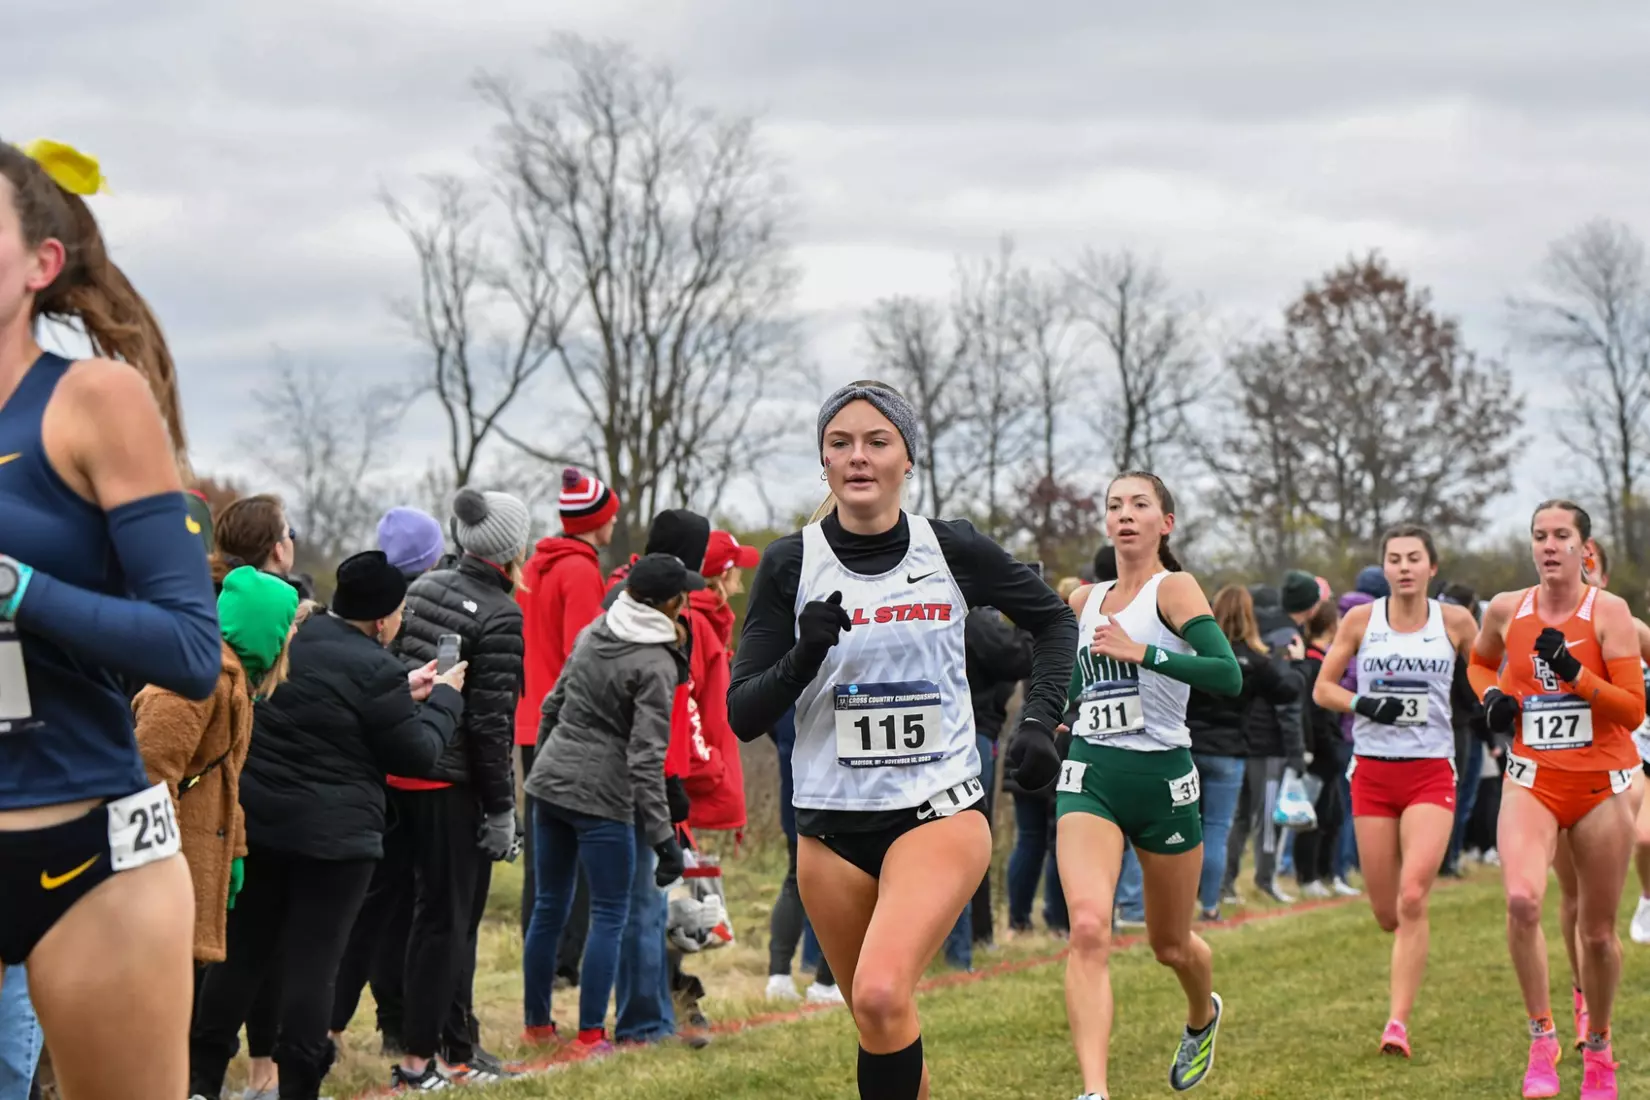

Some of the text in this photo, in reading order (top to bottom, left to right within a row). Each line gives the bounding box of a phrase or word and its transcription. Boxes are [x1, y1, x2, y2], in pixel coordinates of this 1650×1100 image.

[874, 603, 953, 624] STATE
[1363, 655, 1450, 674] CINCINNATI
[848, 696, 868, 704] CROSS
[868, 695, 895, 703] COUNTRY
[1089, 702, 1128, 730] 311
[1534, 714, 1580, 739] 127
[854, 714, 926, 751] 115
